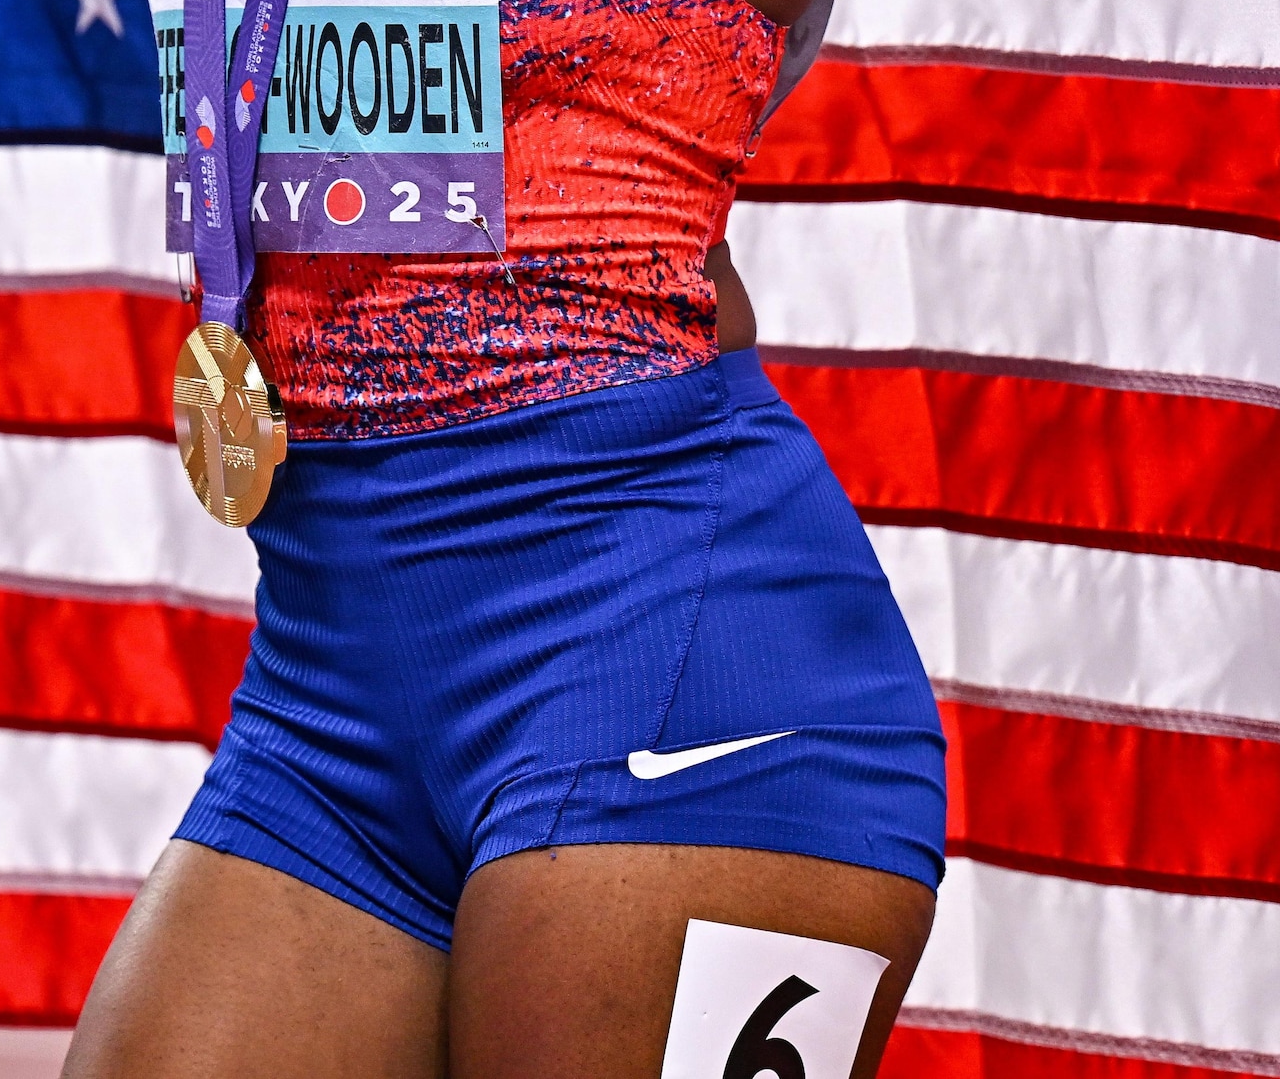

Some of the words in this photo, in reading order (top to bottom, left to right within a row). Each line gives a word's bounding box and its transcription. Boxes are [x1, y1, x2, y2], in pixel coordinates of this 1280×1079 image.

[244, 42, 255, 71] WORLD
[250, 0, 264, 41] ATHLETICS
[248, 1, 268, 73] CHAMPIONSHIPS
[209, 156, 217, 185] WORLD
[471, 140, 490, 149] 1414
[174, 178, 366, 226] TKYO
[205, 155, 216, 227] CHAMPIONSHIPS
[212, 186, 221, 228] ATHLETICS
[722, 974, 820, 1079] 6
